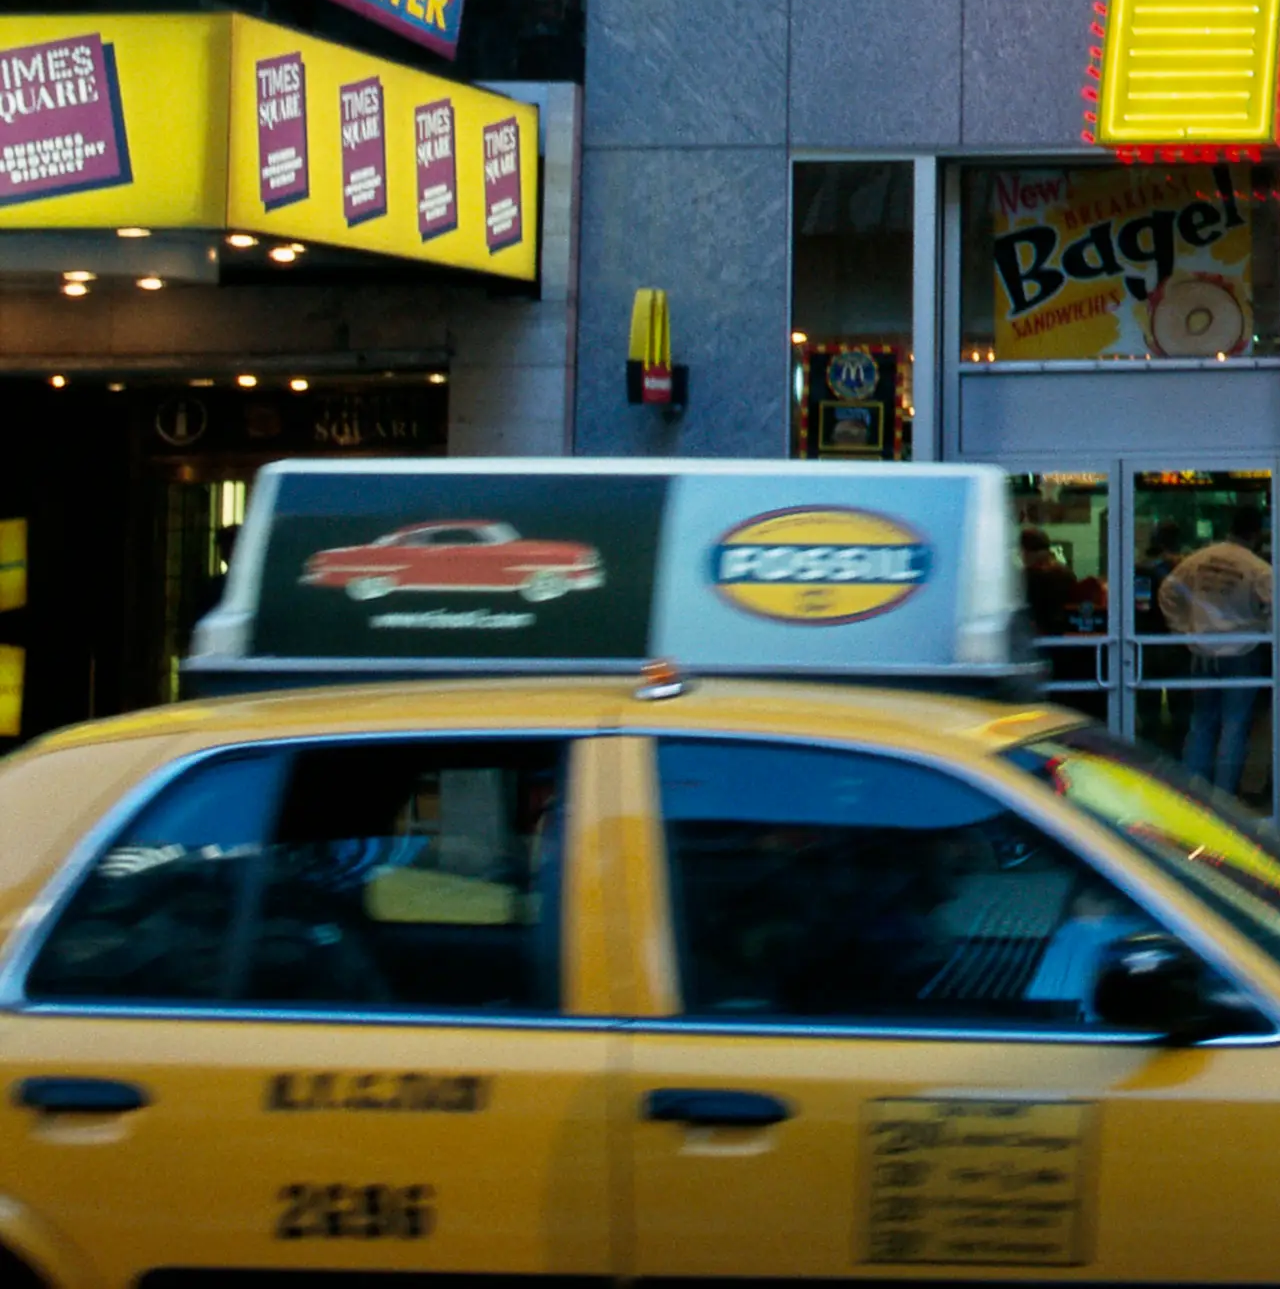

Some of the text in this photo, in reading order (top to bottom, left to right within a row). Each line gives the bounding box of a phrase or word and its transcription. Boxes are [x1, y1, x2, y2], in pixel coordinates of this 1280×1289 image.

[258, 63, 300, 98] TIMES
[994, 162, 1246, 315] Bagel
[720, 546, 925, 583] FOSSIL
